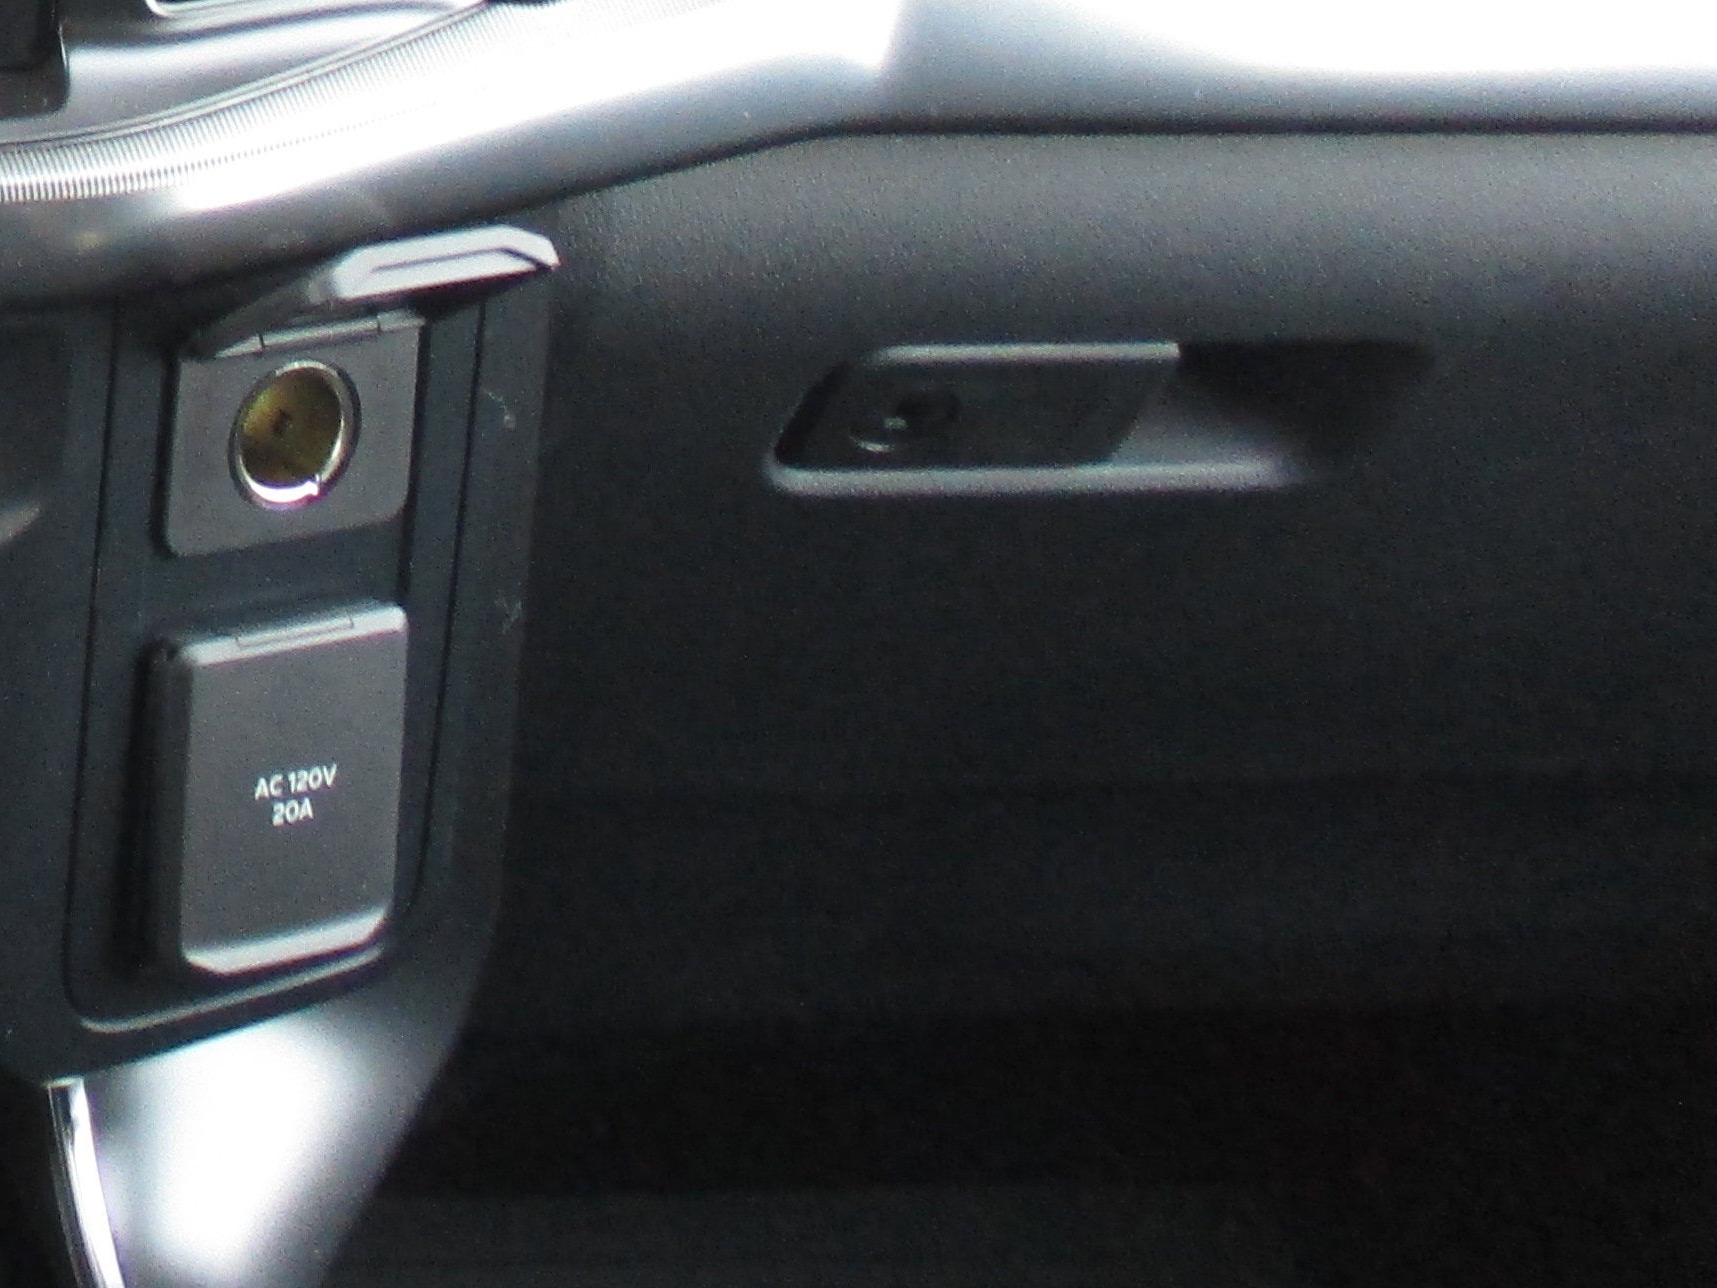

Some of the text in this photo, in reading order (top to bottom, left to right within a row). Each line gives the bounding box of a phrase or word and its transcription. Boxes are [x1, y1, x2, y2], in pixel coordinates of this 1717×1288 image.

[254, 763, 338, 801] AC 120V
[272, 796, 314, 827] 20A
